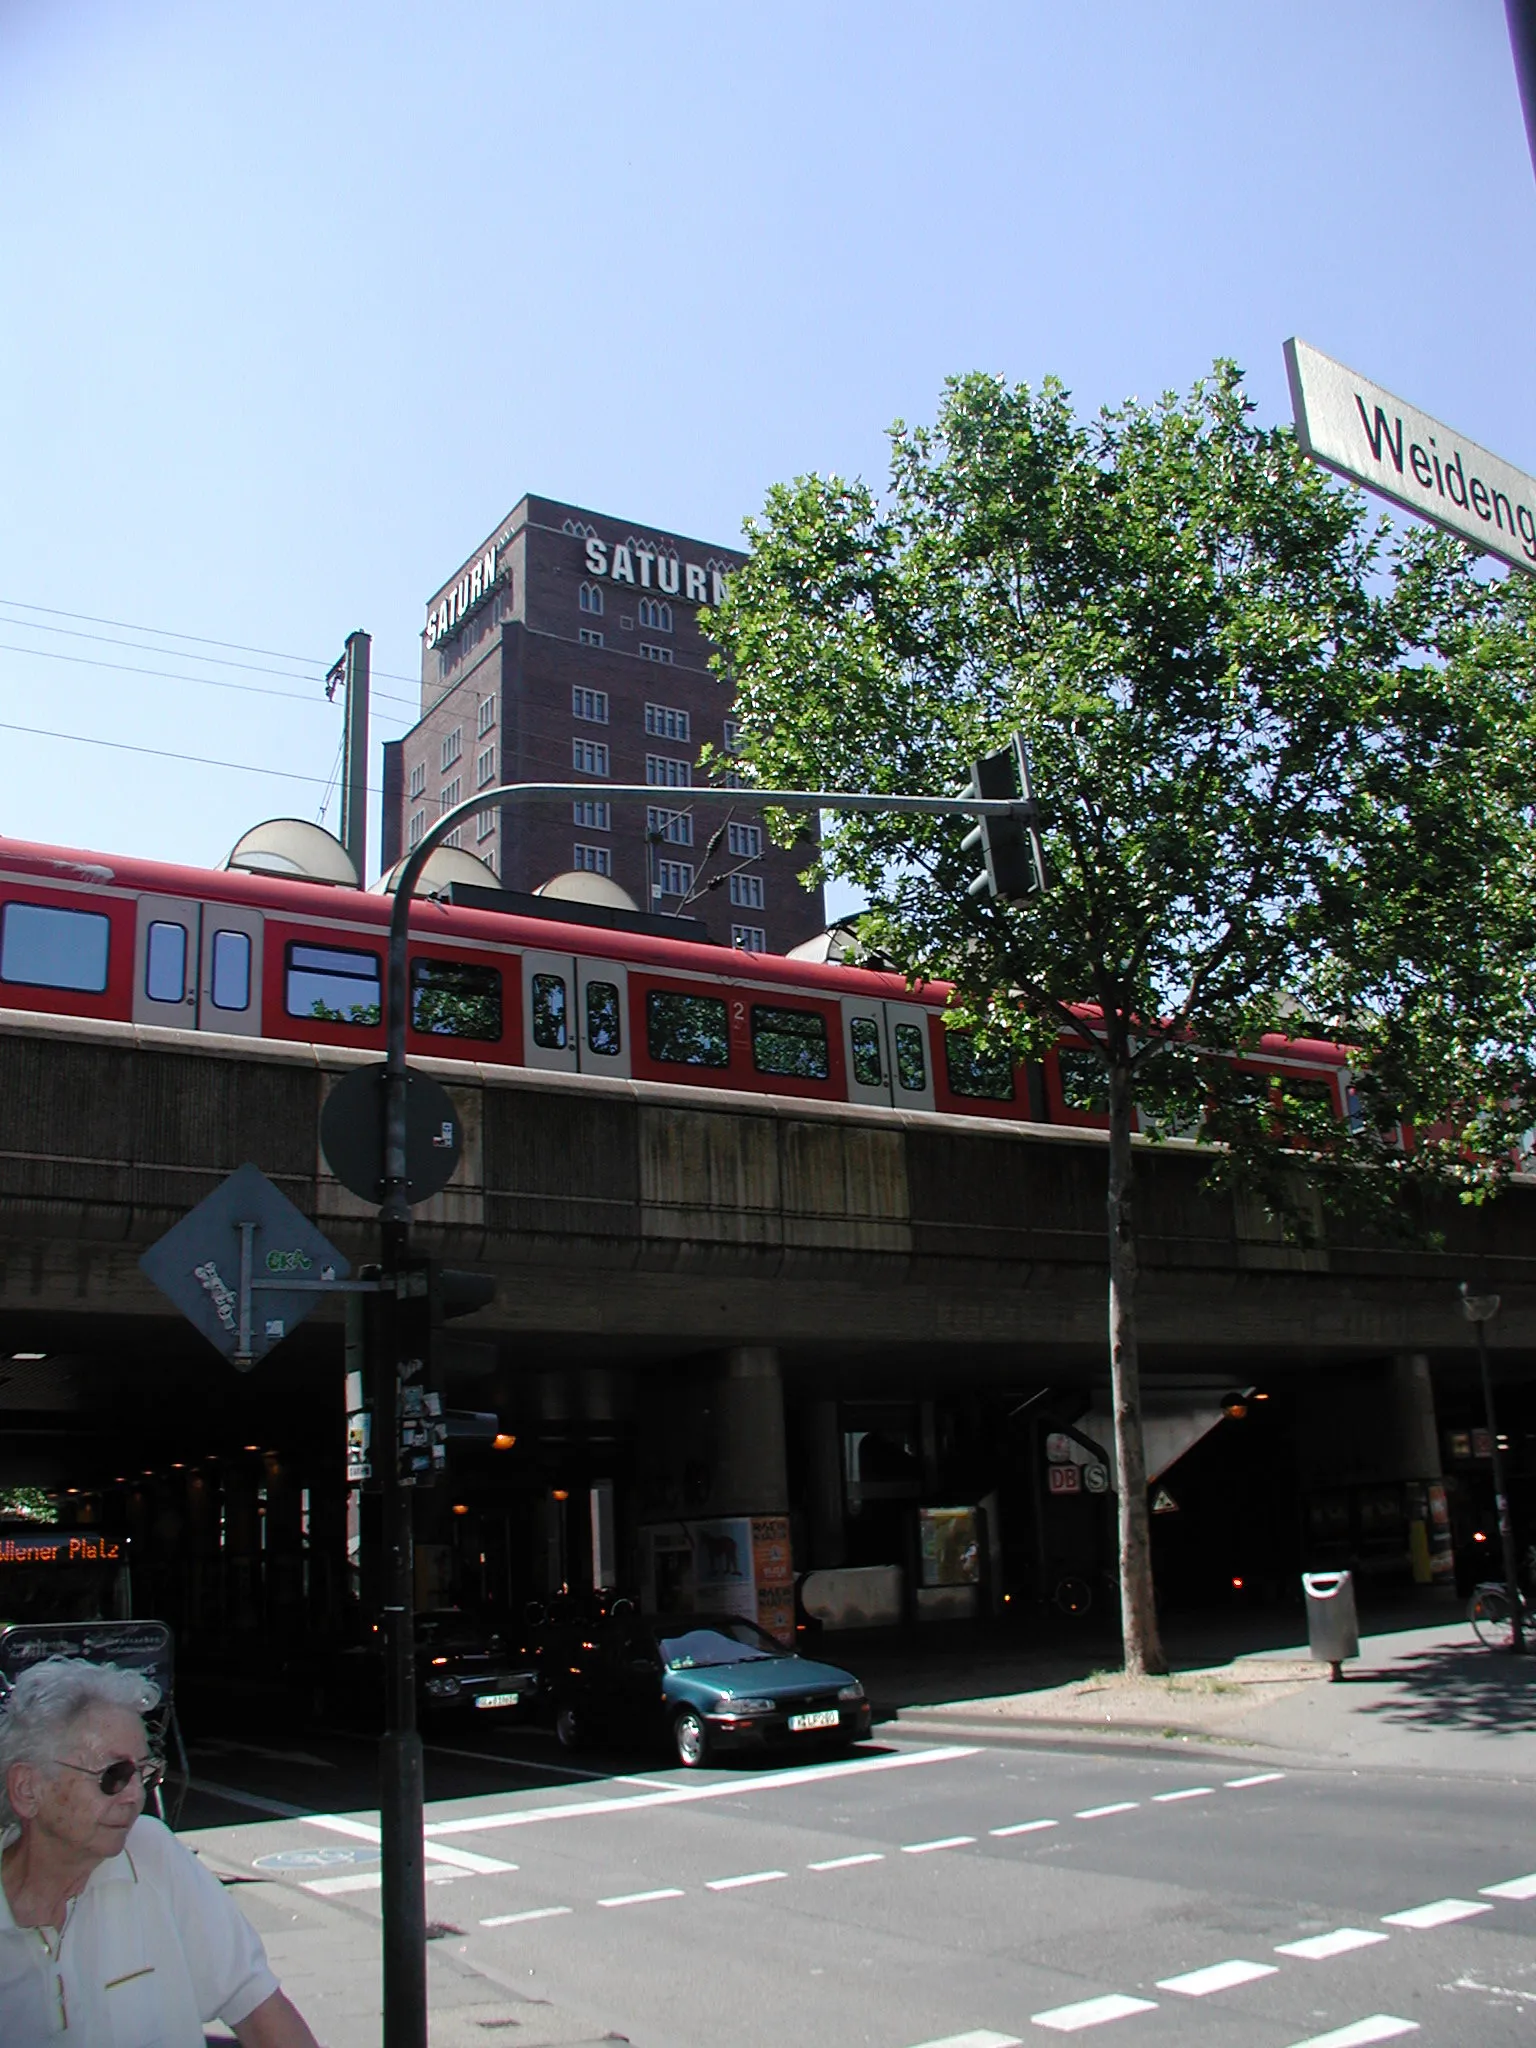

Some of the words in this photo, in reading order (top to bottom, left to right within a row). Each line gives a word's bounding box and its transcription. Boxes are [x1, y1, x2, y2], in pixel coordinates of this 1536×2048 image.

[1354, 393, 1536, 562] Weideng
[425, 546, 497, 650] SATURN
[733, 1002, 744, 1020] 2
[1052, 1469, 1076, 1488] DB
[1088, 1465, 1106, 1490] S
[69, 1537, 119, 1560] Platz
